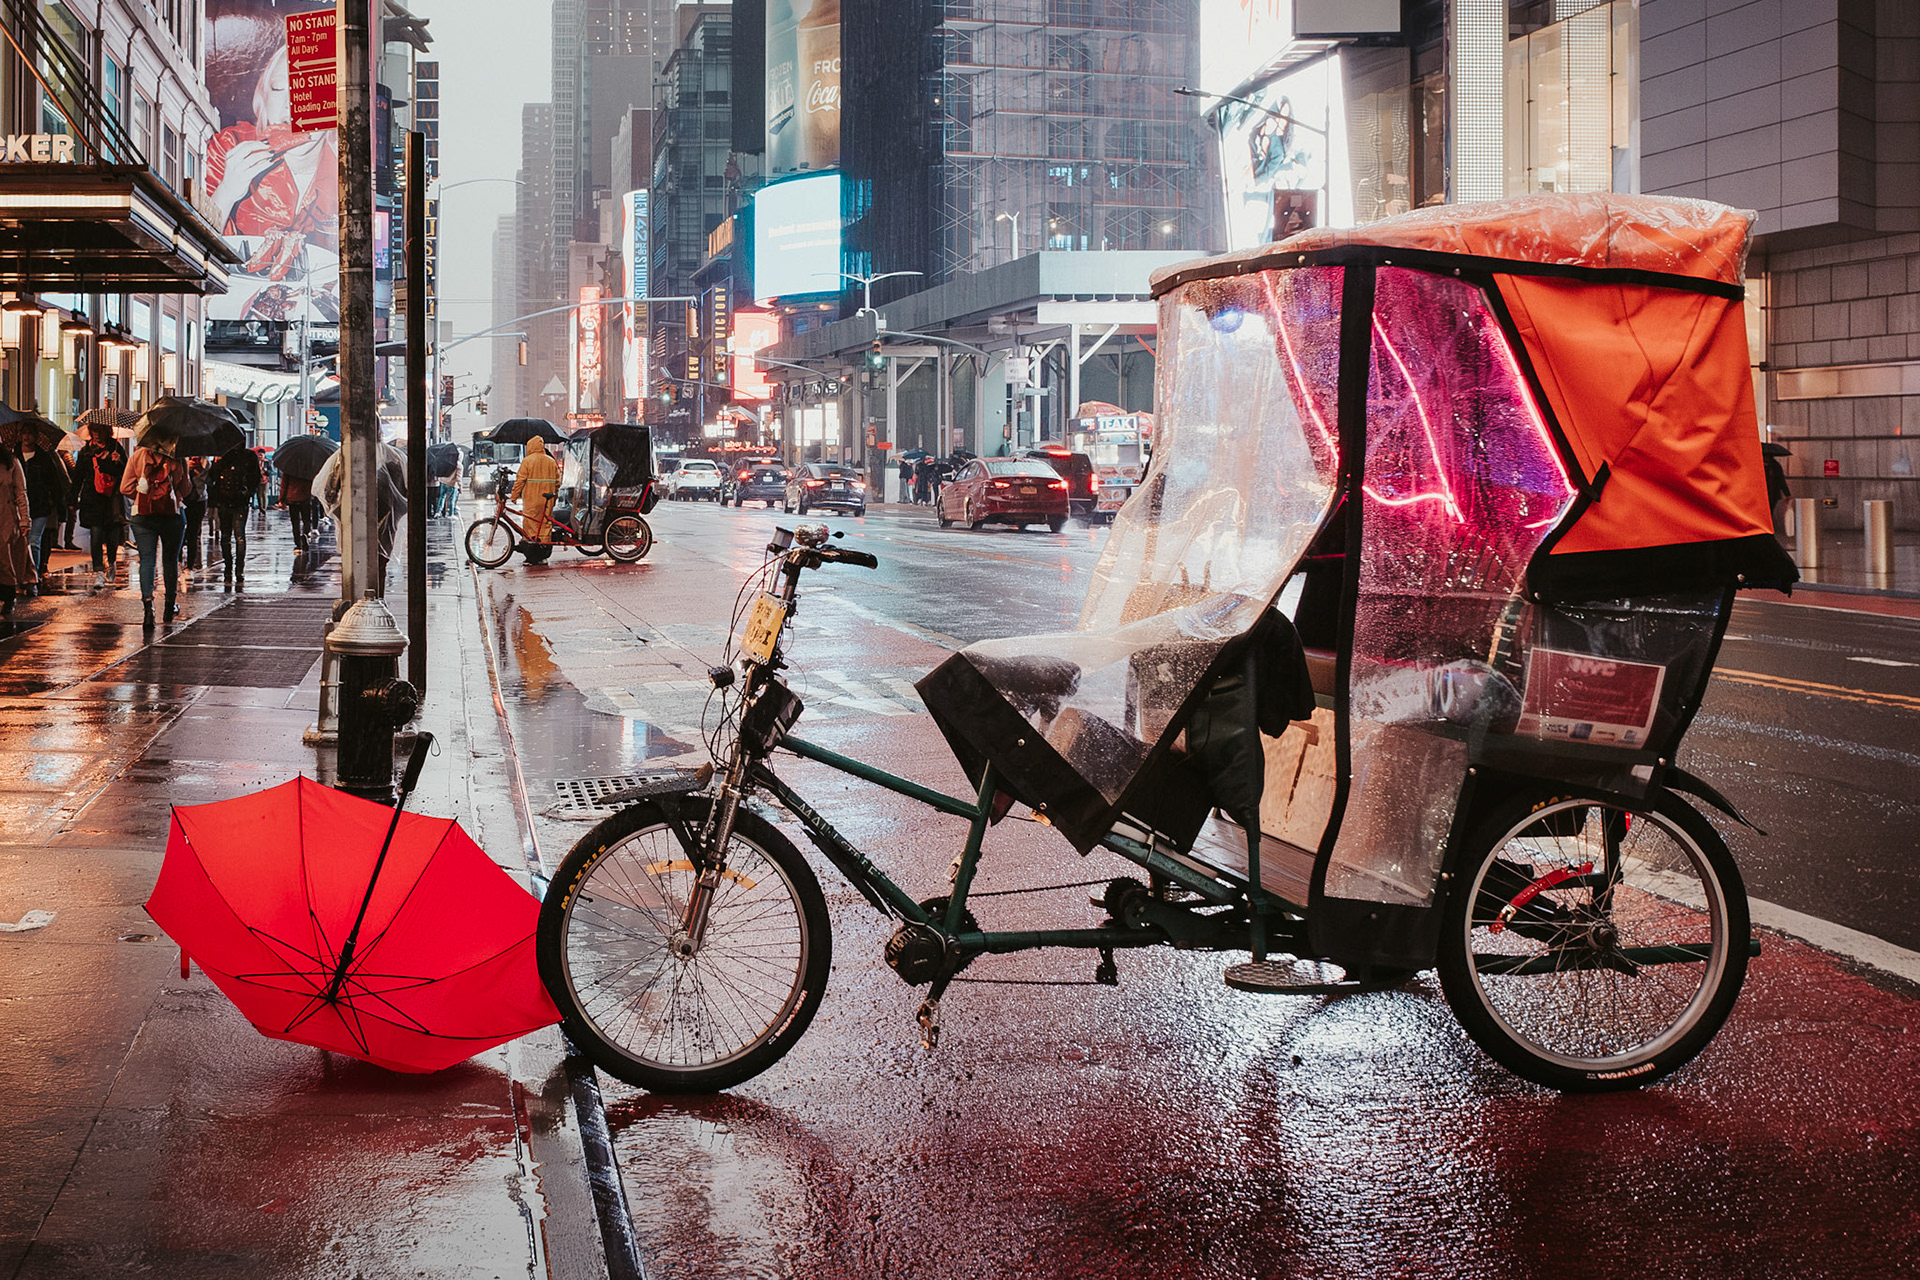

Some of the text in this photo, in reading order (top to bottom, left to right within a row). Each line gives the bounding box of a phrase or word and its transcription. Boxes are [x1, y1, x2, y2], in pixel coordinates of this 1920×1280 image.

[290, 19, 303, 32] NO
[291, 34, 306, 44] 7am
[311, 32, 328, 42] 7pm
[291, 44, 319, 55] All Days
[292, 77, 305, 89] NO
[293, 91, 312, 102] Hotel
[293, 100, 338, 113] Loading Zon
[0, 134, 75, 162] KER
[634, 193, 648, 217] NEW
[634, 256, 648, 299] STUDIOS
[714, 287, 726, 339] VICTORY
[561, 844, 607, 910] MAXXIS
